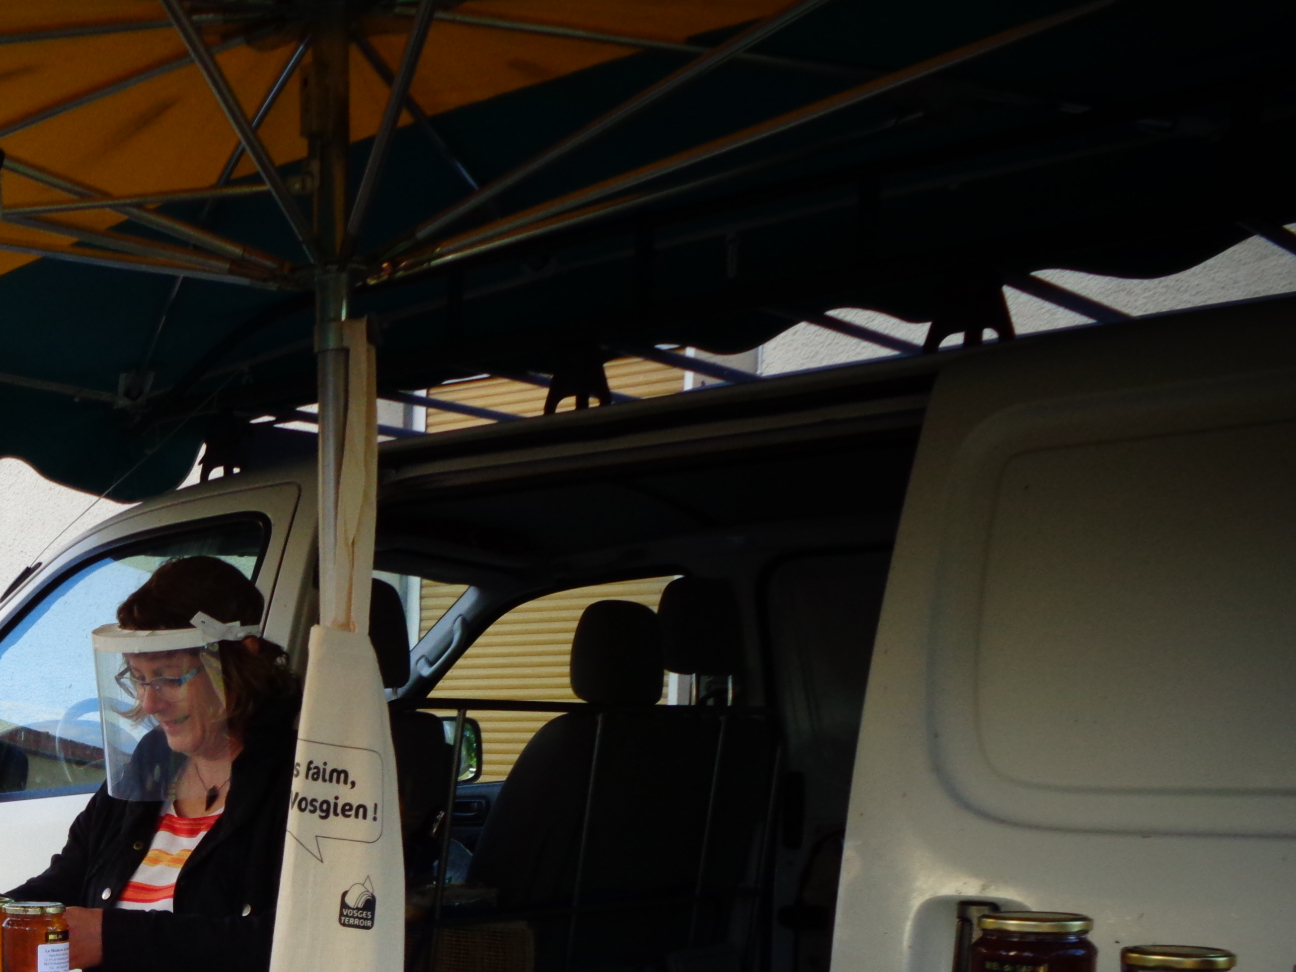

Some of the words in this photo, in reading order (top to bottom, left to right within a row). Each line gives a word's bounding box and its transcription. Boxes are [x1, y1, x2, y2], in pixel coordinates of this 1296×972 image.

[305, 760, 357, 790] faim,
[342, 908, 372, 919] VOSGES
[341, 916, 373, 927] TERROIR
